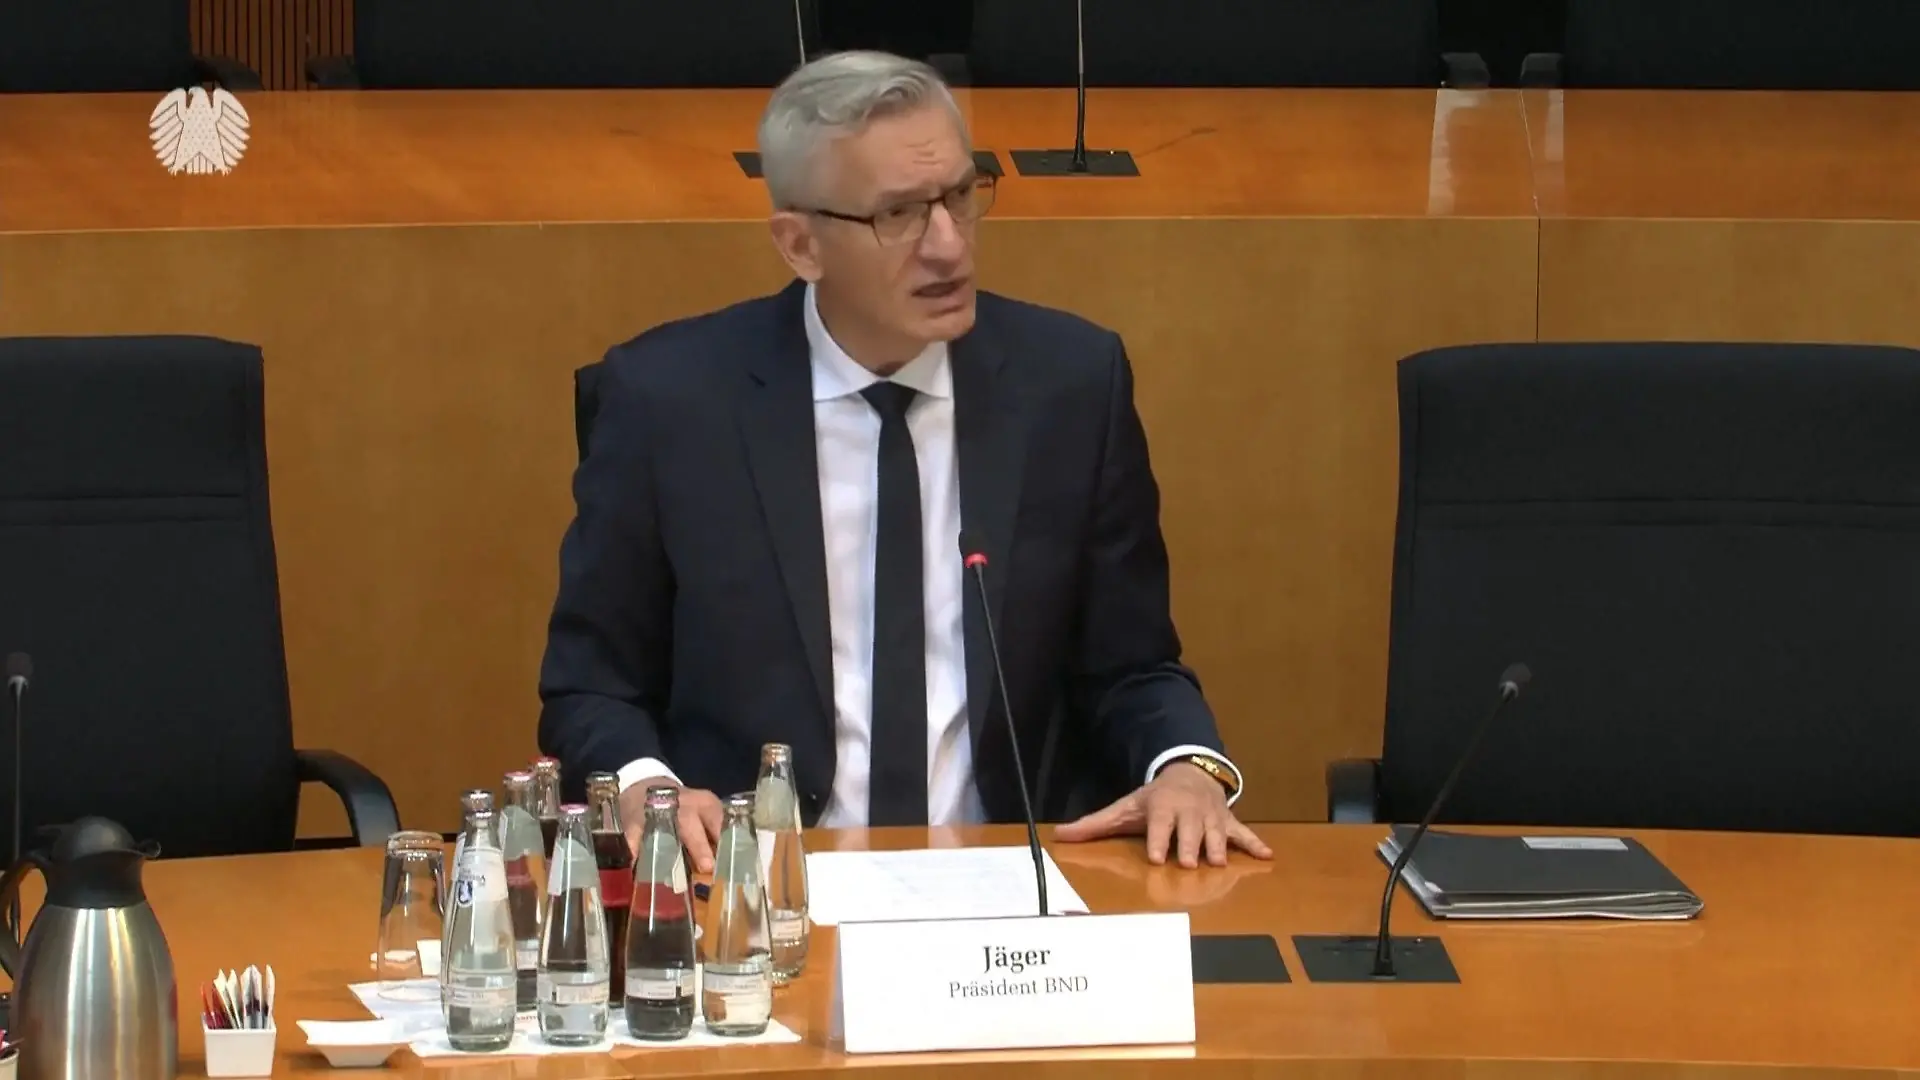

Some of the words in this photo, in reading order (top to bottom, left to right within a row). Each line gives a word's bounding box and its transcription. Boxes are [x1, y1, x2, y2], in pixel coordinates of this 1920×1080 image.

[983, 945, 1051, 974] Jäger
[949, 978, 1037, 998] Präsident
[1045, 976, 1088, 993] BND
